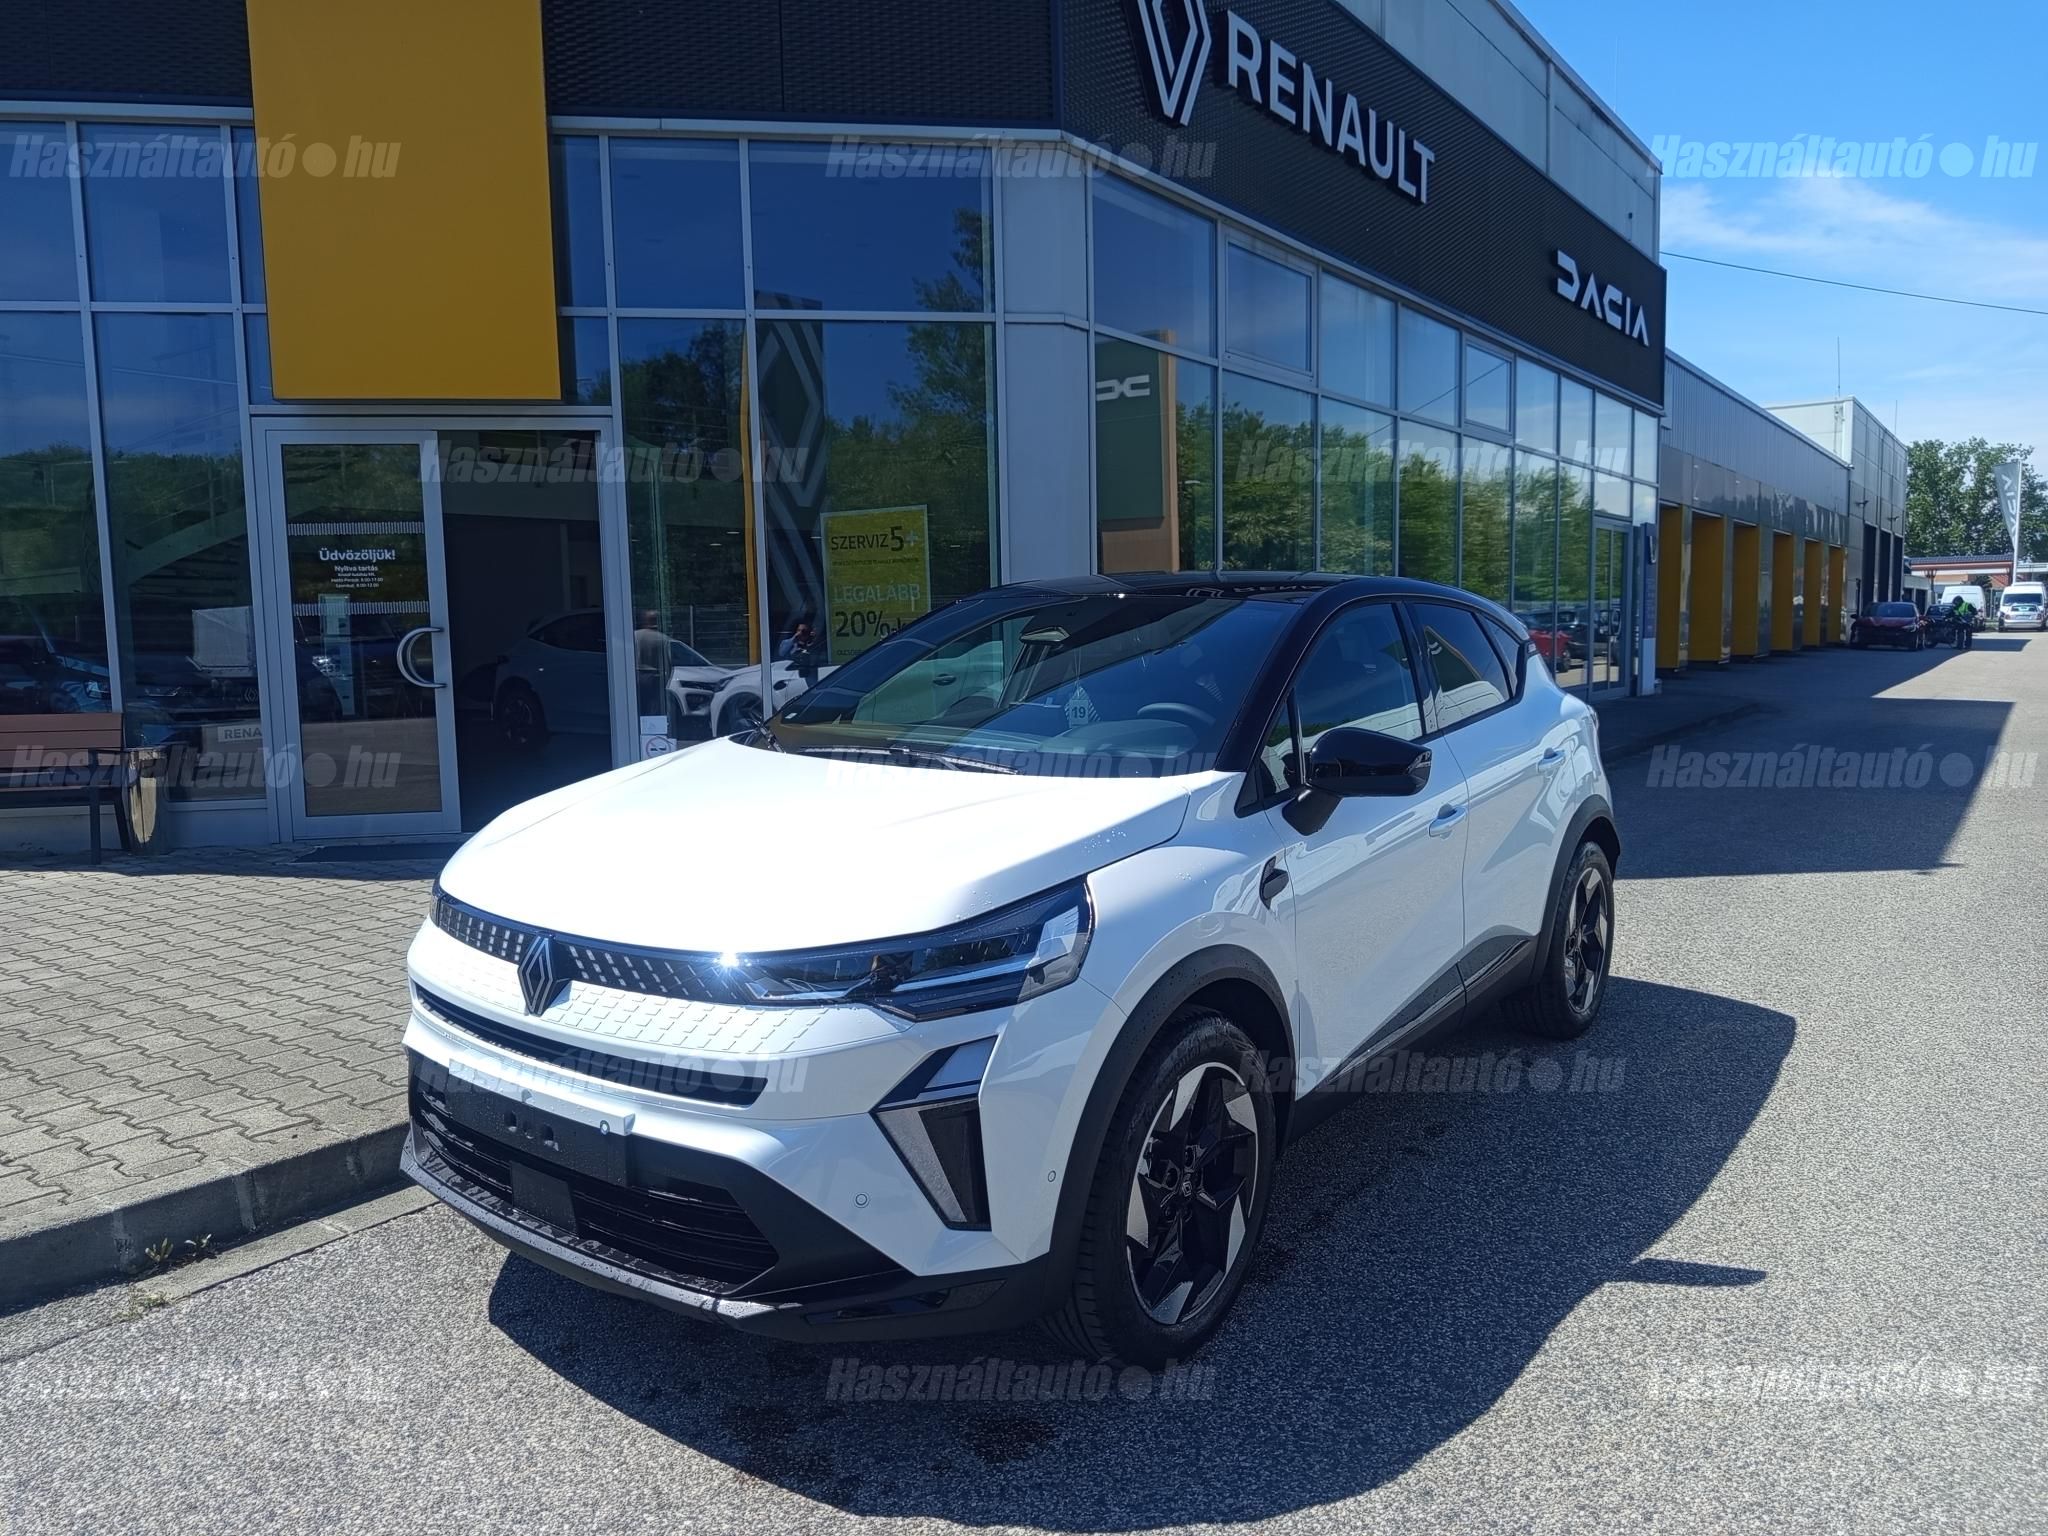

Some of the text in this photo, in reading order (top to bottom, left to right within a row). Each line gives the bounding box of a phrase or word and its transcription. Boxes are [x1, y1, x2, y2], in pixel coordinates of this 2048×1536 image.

[1227, 9, 1435, 205] RENAULT
[1555, 249, 1650, 348] DACIA
[831, 533, 889, 551] SZERVIZ
[319, 547, 396, 563] Üdvözöljük!
[833, 579, 921, 602] LEGALÁBB
[1071, 706, 1086, 719] 19
